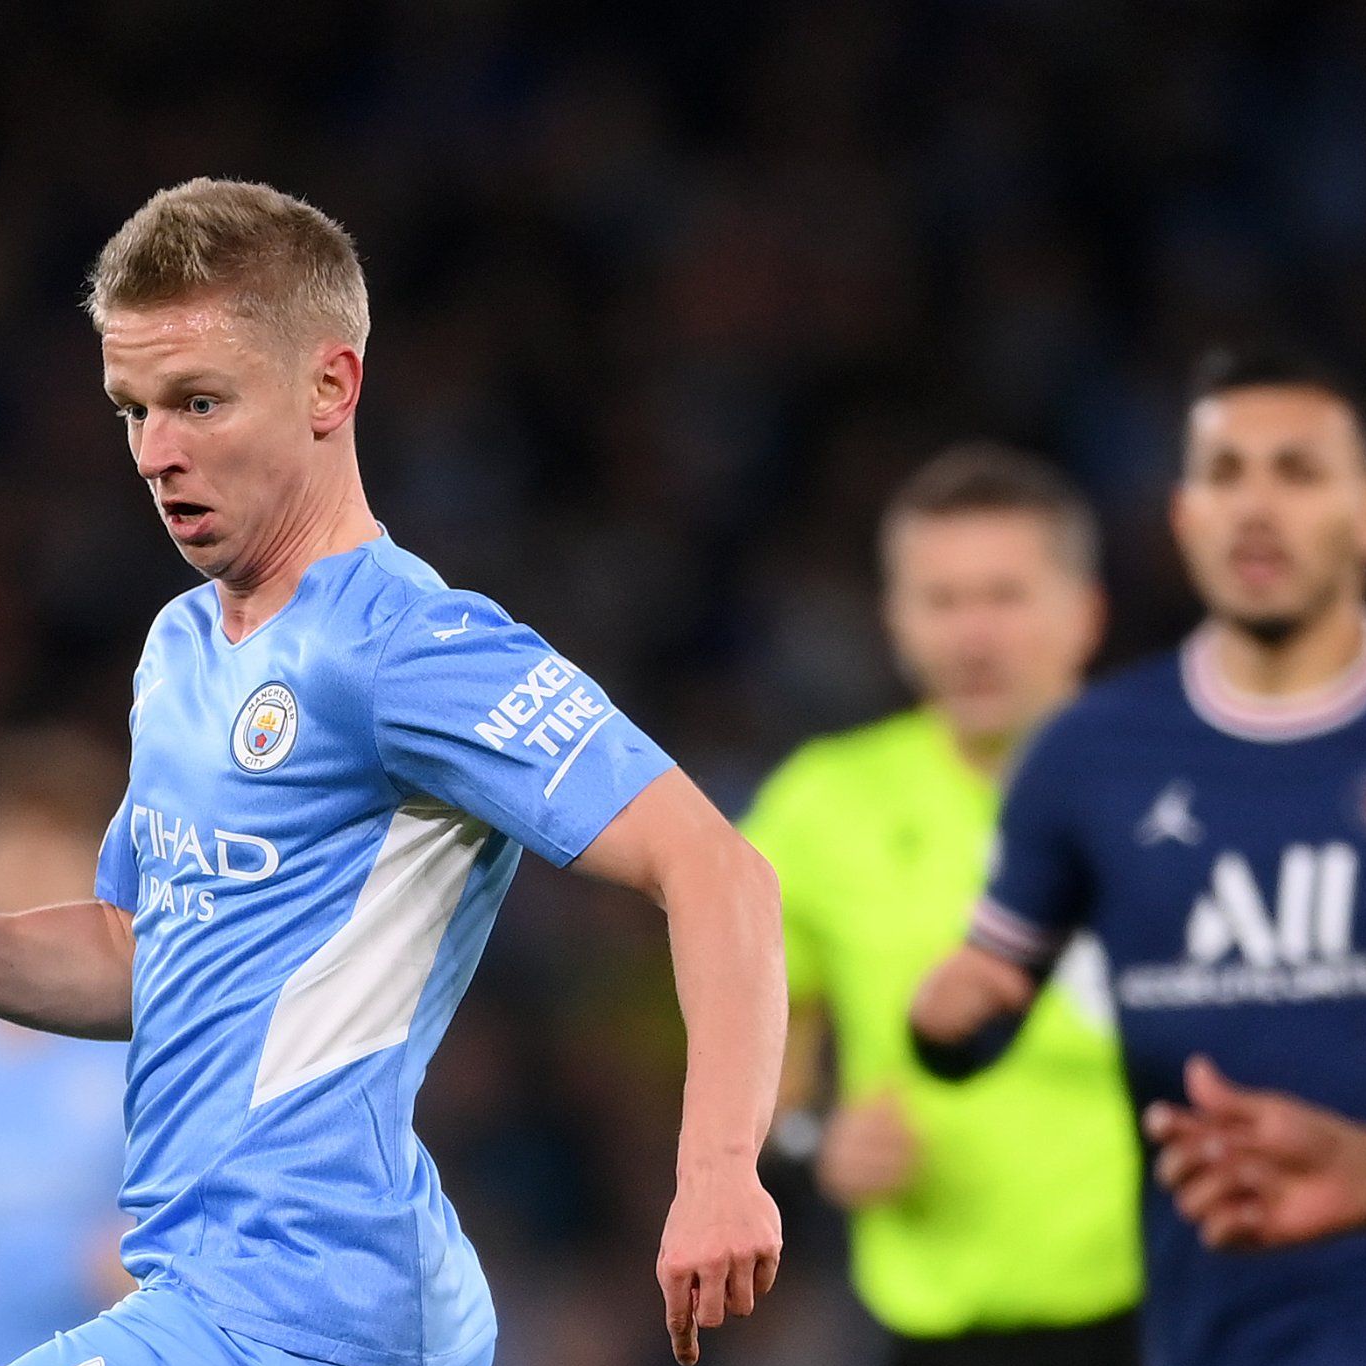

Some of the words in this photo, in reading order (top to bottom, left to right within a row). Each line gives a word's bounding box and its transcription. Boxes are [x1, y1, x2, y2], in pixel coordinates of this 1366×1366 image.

[248, 688, 295, 720] MANCHESTER
[523, 686, 604, 757] TIRE
[244, 756, 265, 767] CITY
[130, 804, 279, 881] TIHAD
